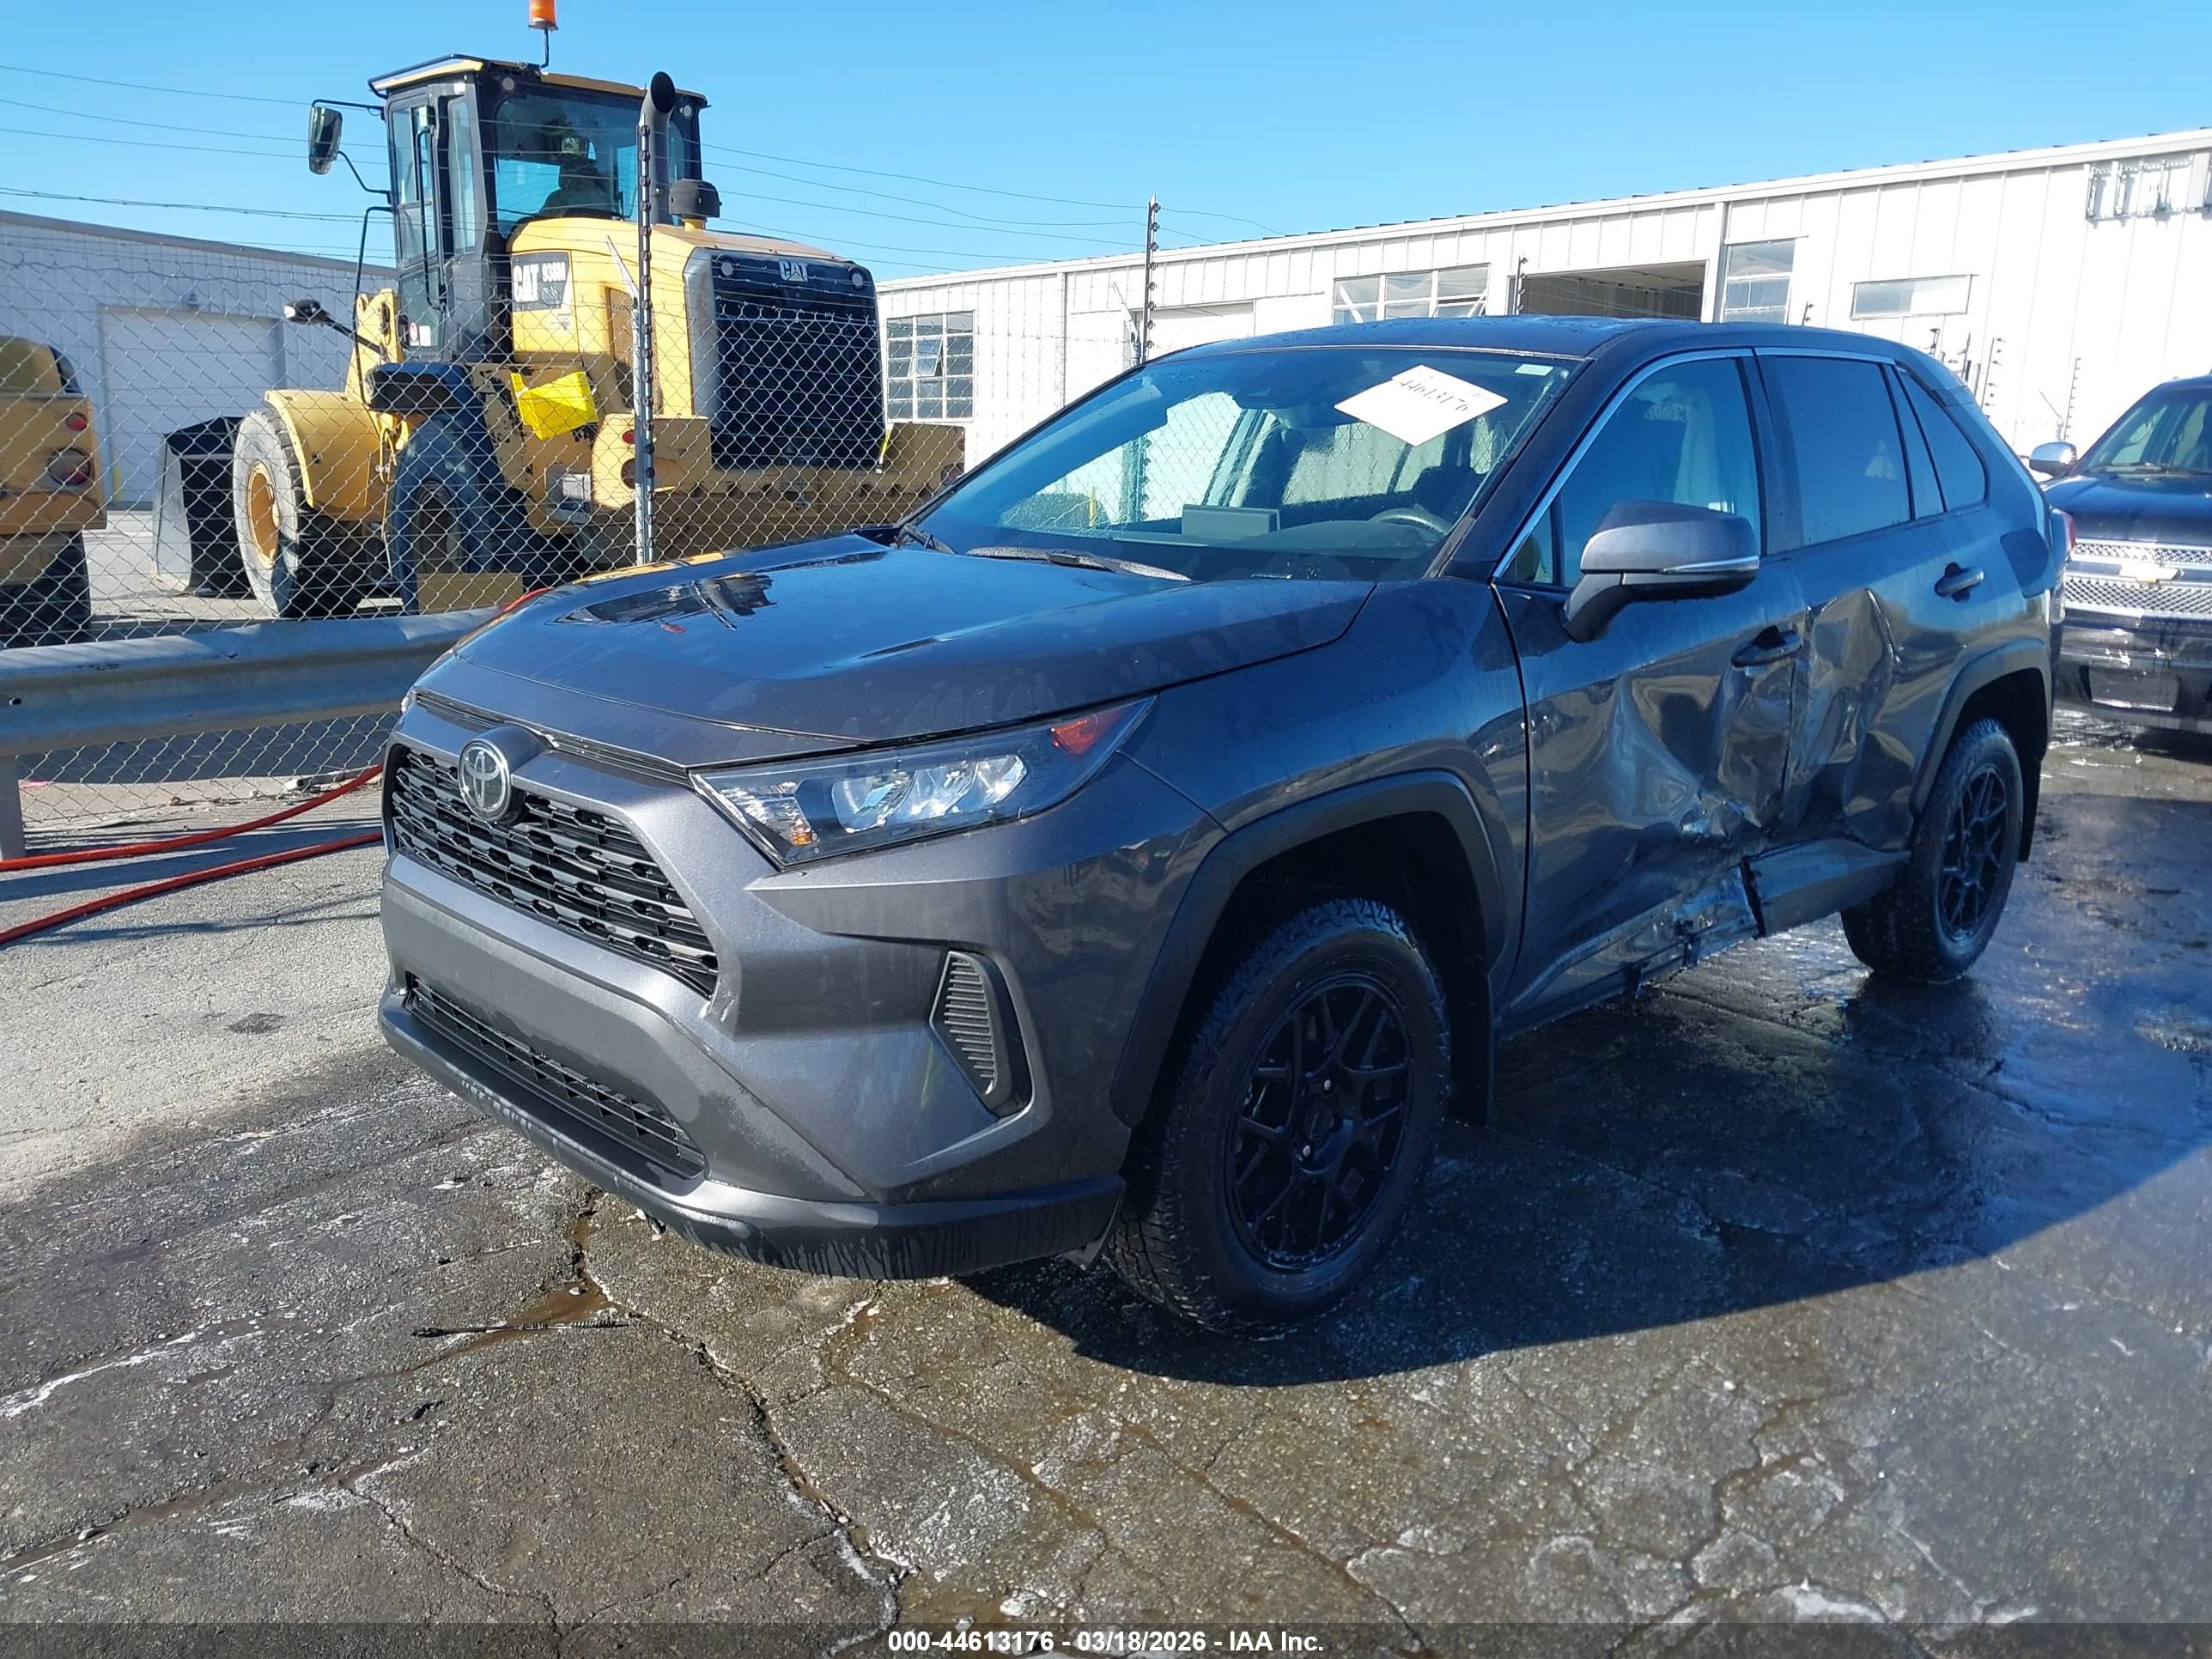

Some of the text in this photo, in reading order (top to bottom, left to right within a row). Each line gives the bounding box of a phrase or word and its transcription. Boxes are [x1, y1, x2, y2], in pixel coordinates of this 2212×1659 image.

[513, 261, 567, 303] CAT 938M
[778, 260, 808, 282] CAT
